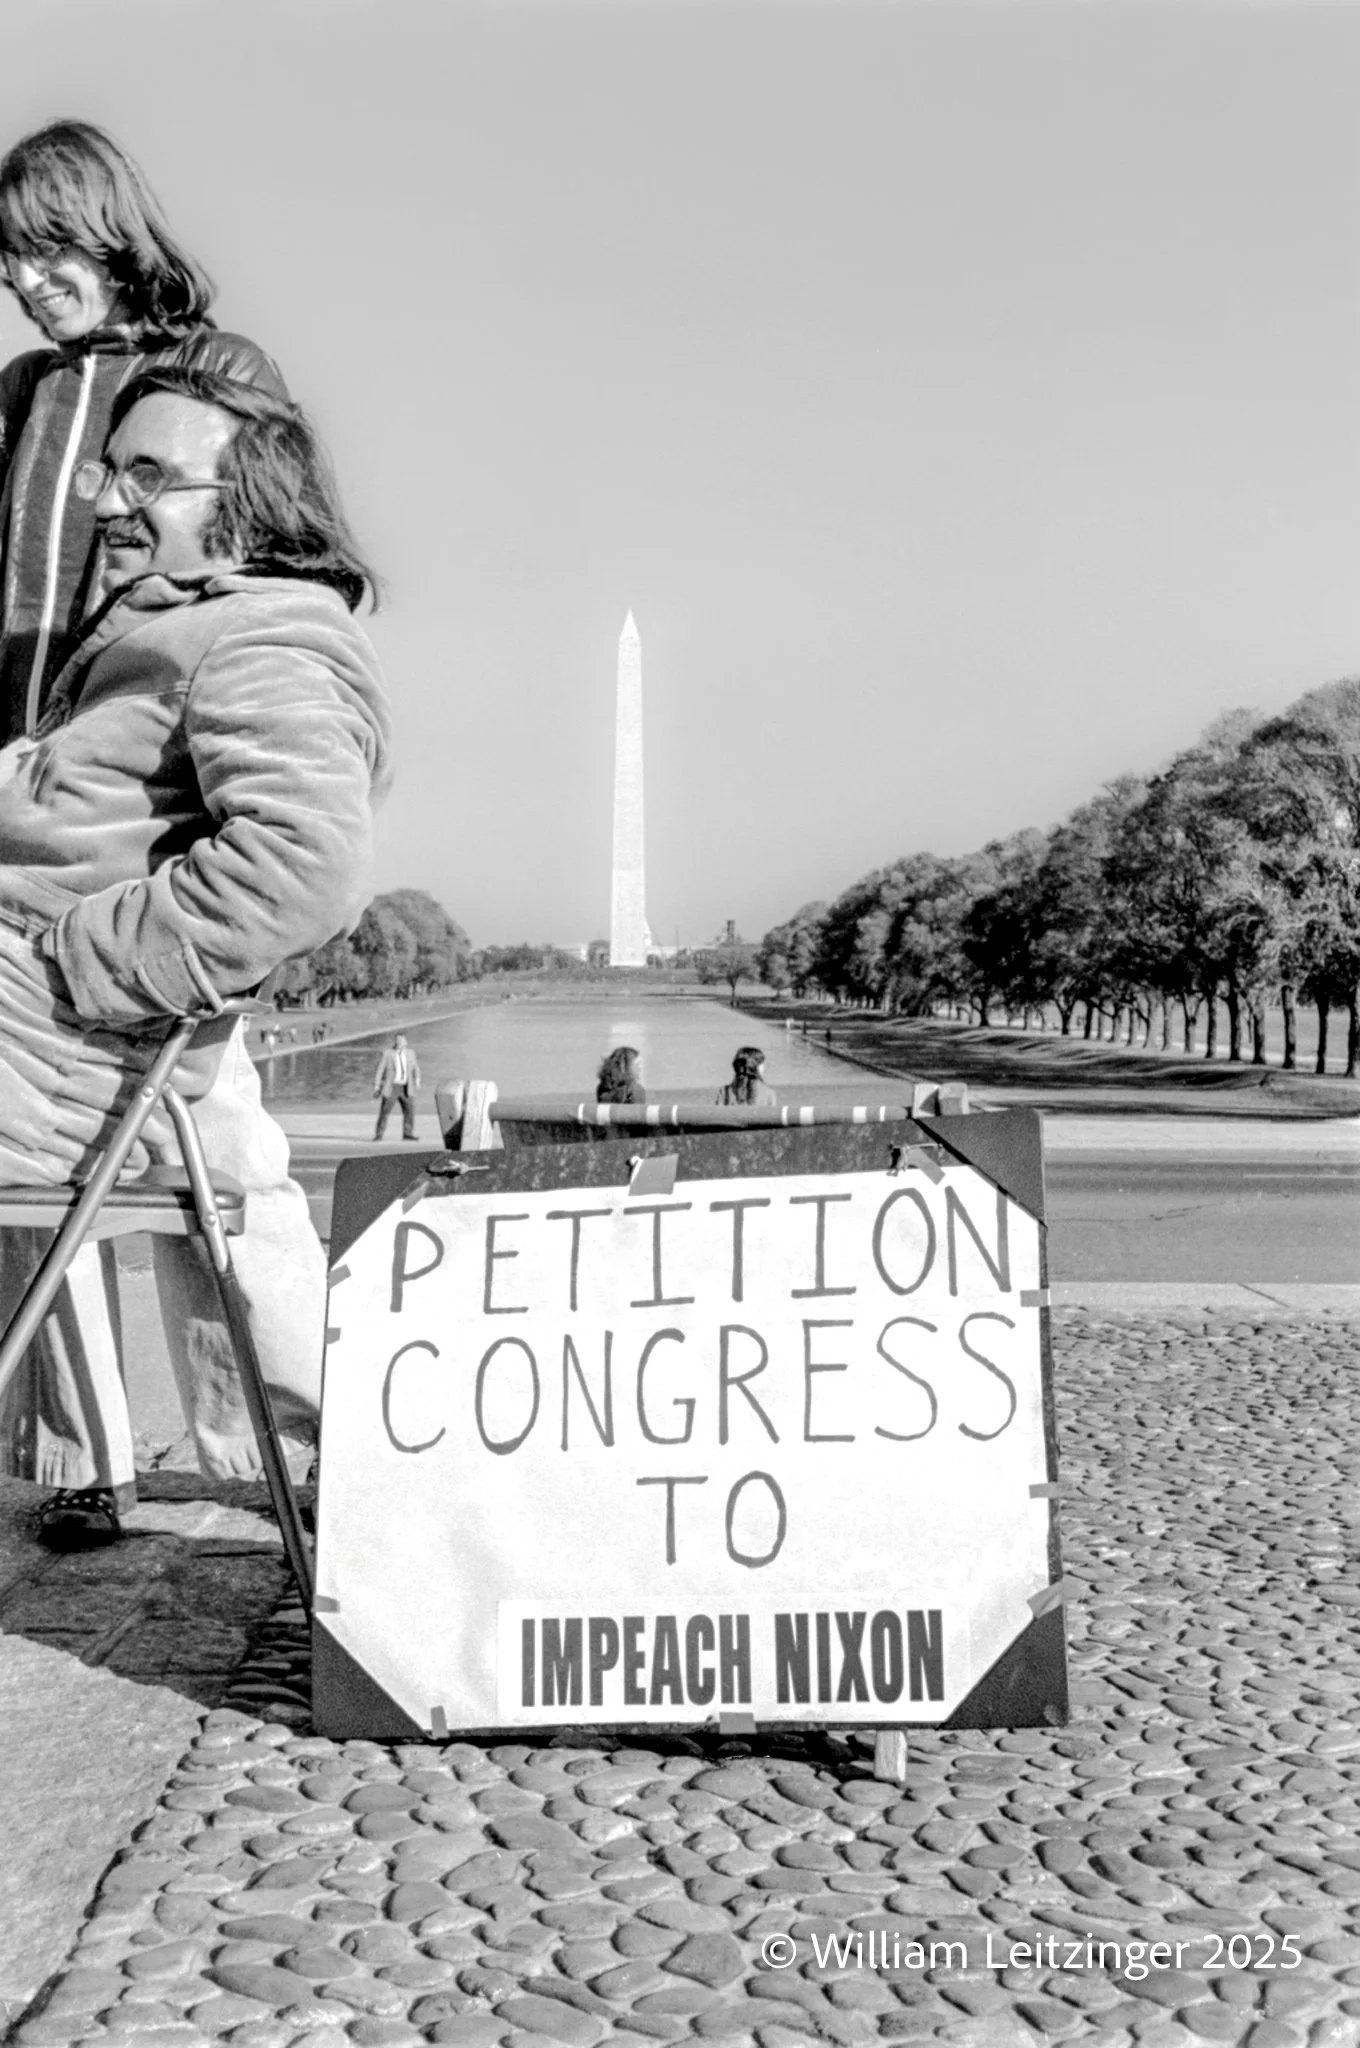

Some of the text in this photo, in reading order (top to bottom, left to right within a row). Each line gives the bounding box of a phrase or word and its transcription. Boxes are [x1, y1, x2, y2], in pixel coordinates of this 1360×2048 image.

[389, 1185, 1013, 1314] PETITION
[381, 1311, 1018, 1456] CONGRESS
[636, 1470, 788, 1569] TO
[520, 1609, 945, 1707] IMPEACH NIXON
